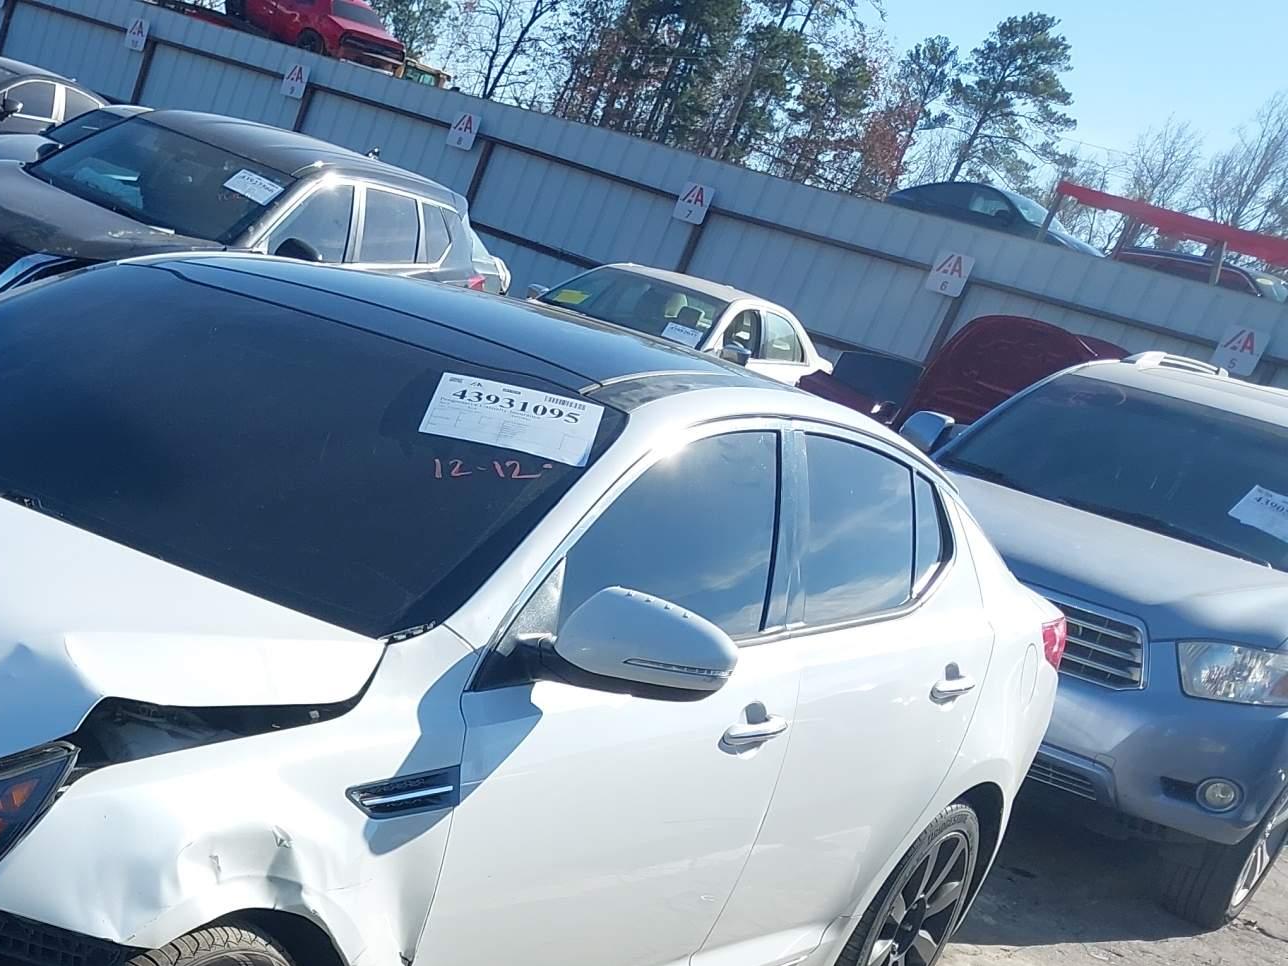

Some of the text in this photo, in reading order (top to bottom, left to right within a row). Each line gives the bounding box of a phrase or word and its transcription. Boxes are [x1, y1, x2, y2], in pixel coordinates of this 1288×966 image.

[456, 136, 463, 145] 8
[685, 209, 693, 218] 7
[939, 281, 949, 291] 6
[1227, 358, 1238, 369] 5
[452, 387, 580, 424] 43931095
